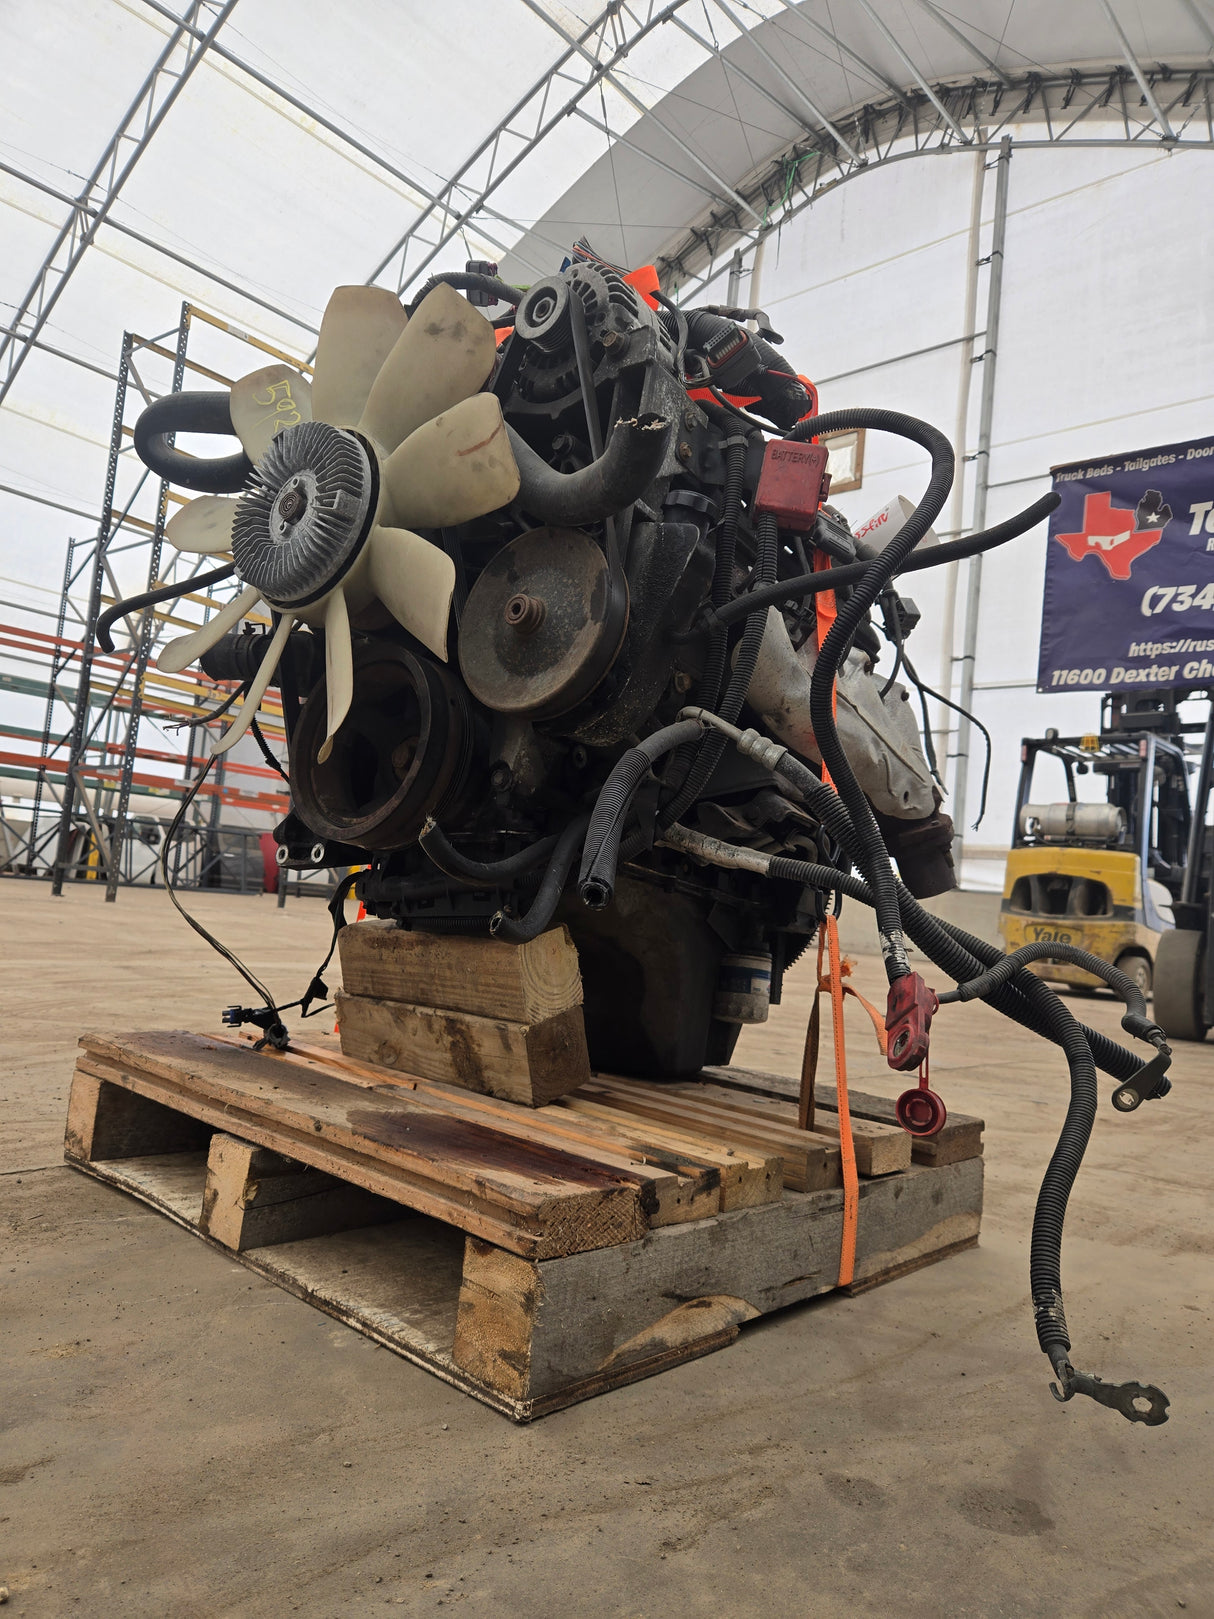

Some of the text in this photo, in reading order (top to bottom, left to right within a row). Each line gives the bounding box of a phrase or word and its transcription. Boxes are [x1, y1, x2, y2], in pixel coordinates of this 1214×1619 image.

[1055, 468, 1085, 482] Truck
[1085, 464, 1114, 479] Beds
[1123, 453, 1176, 472] Tailgates
[1051, 667, 1107, 686] 11600
[1109, 664, 1180, 684] Dexter
[1033, 927, 1072, 944] Yale
